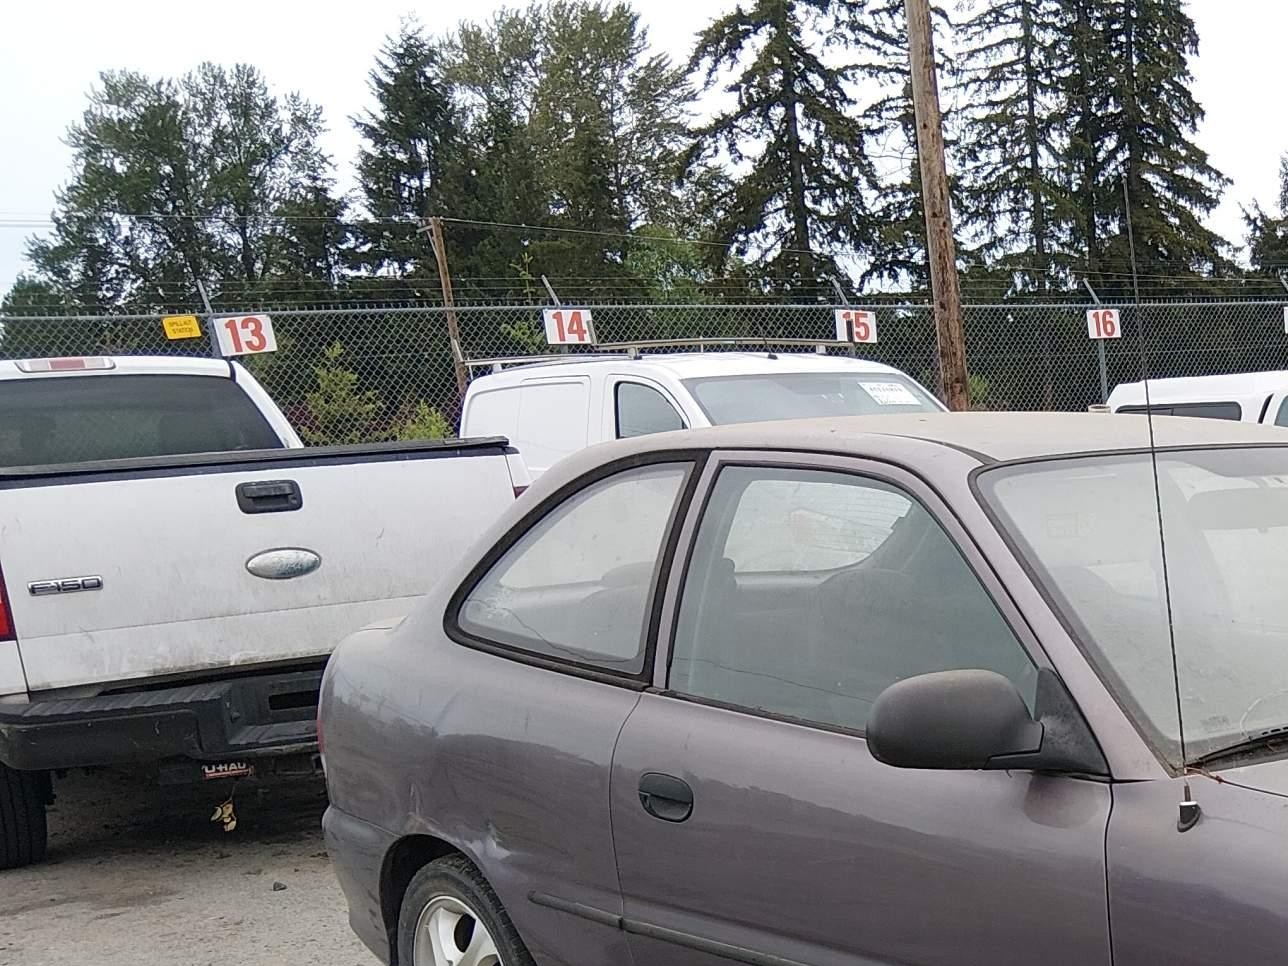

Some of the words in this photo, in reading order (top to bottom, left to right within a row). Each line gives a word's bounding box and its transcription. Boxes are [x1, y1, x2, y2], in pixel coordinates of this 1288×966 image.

[224, 317, 267, 353] 13
[552, 311, 587, 342] 14
[1092, 310, 1116, 337] 16
